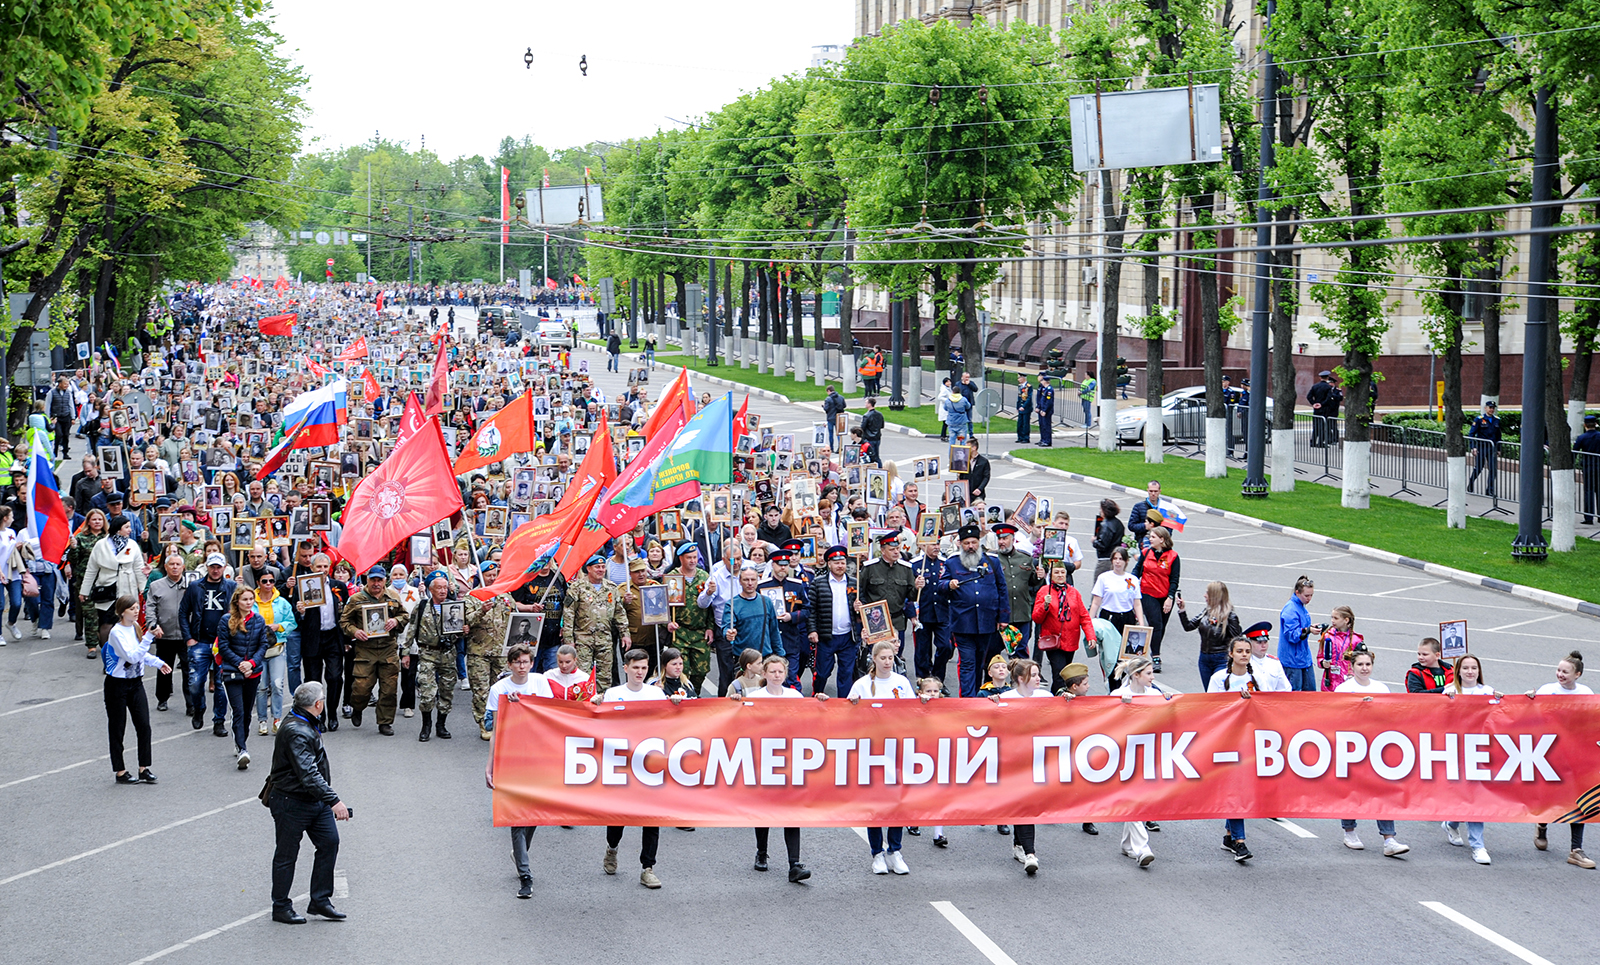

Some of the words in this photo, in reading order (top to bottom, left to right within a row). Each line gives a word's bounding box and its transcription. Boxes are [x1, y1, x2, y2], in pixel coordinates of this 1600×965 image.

[563, 725, 999, 787] БЕССМЕРТНЫЙ
[1032, 731, 1201, 783] ПОЛК
[1254, 729, 1561, 782] ВОРОНЕЖ
